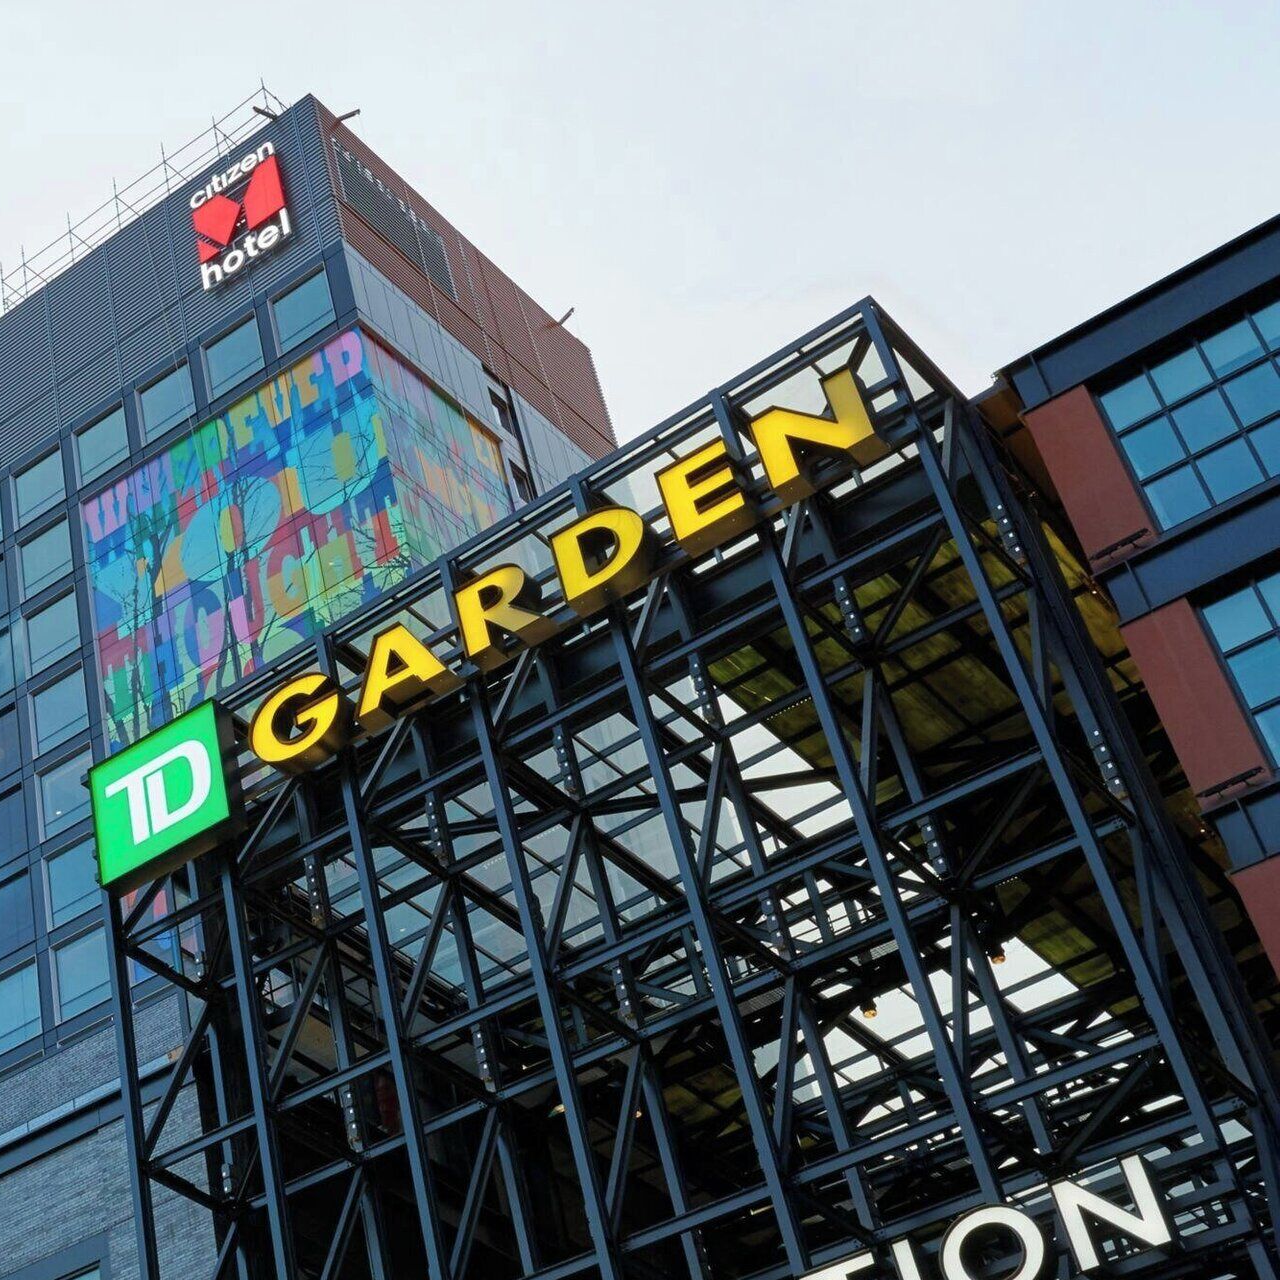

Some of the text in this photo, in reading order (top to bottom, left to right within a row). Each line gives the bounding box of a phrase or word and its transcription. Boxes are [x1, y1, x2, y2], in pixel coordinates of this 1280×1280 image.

[190, 141, 275, 209] citizen
[200, 208, 291, 290] hotel
[104, 740, 213, 846] TD
[248, 367, 888, 766] GARDEN
